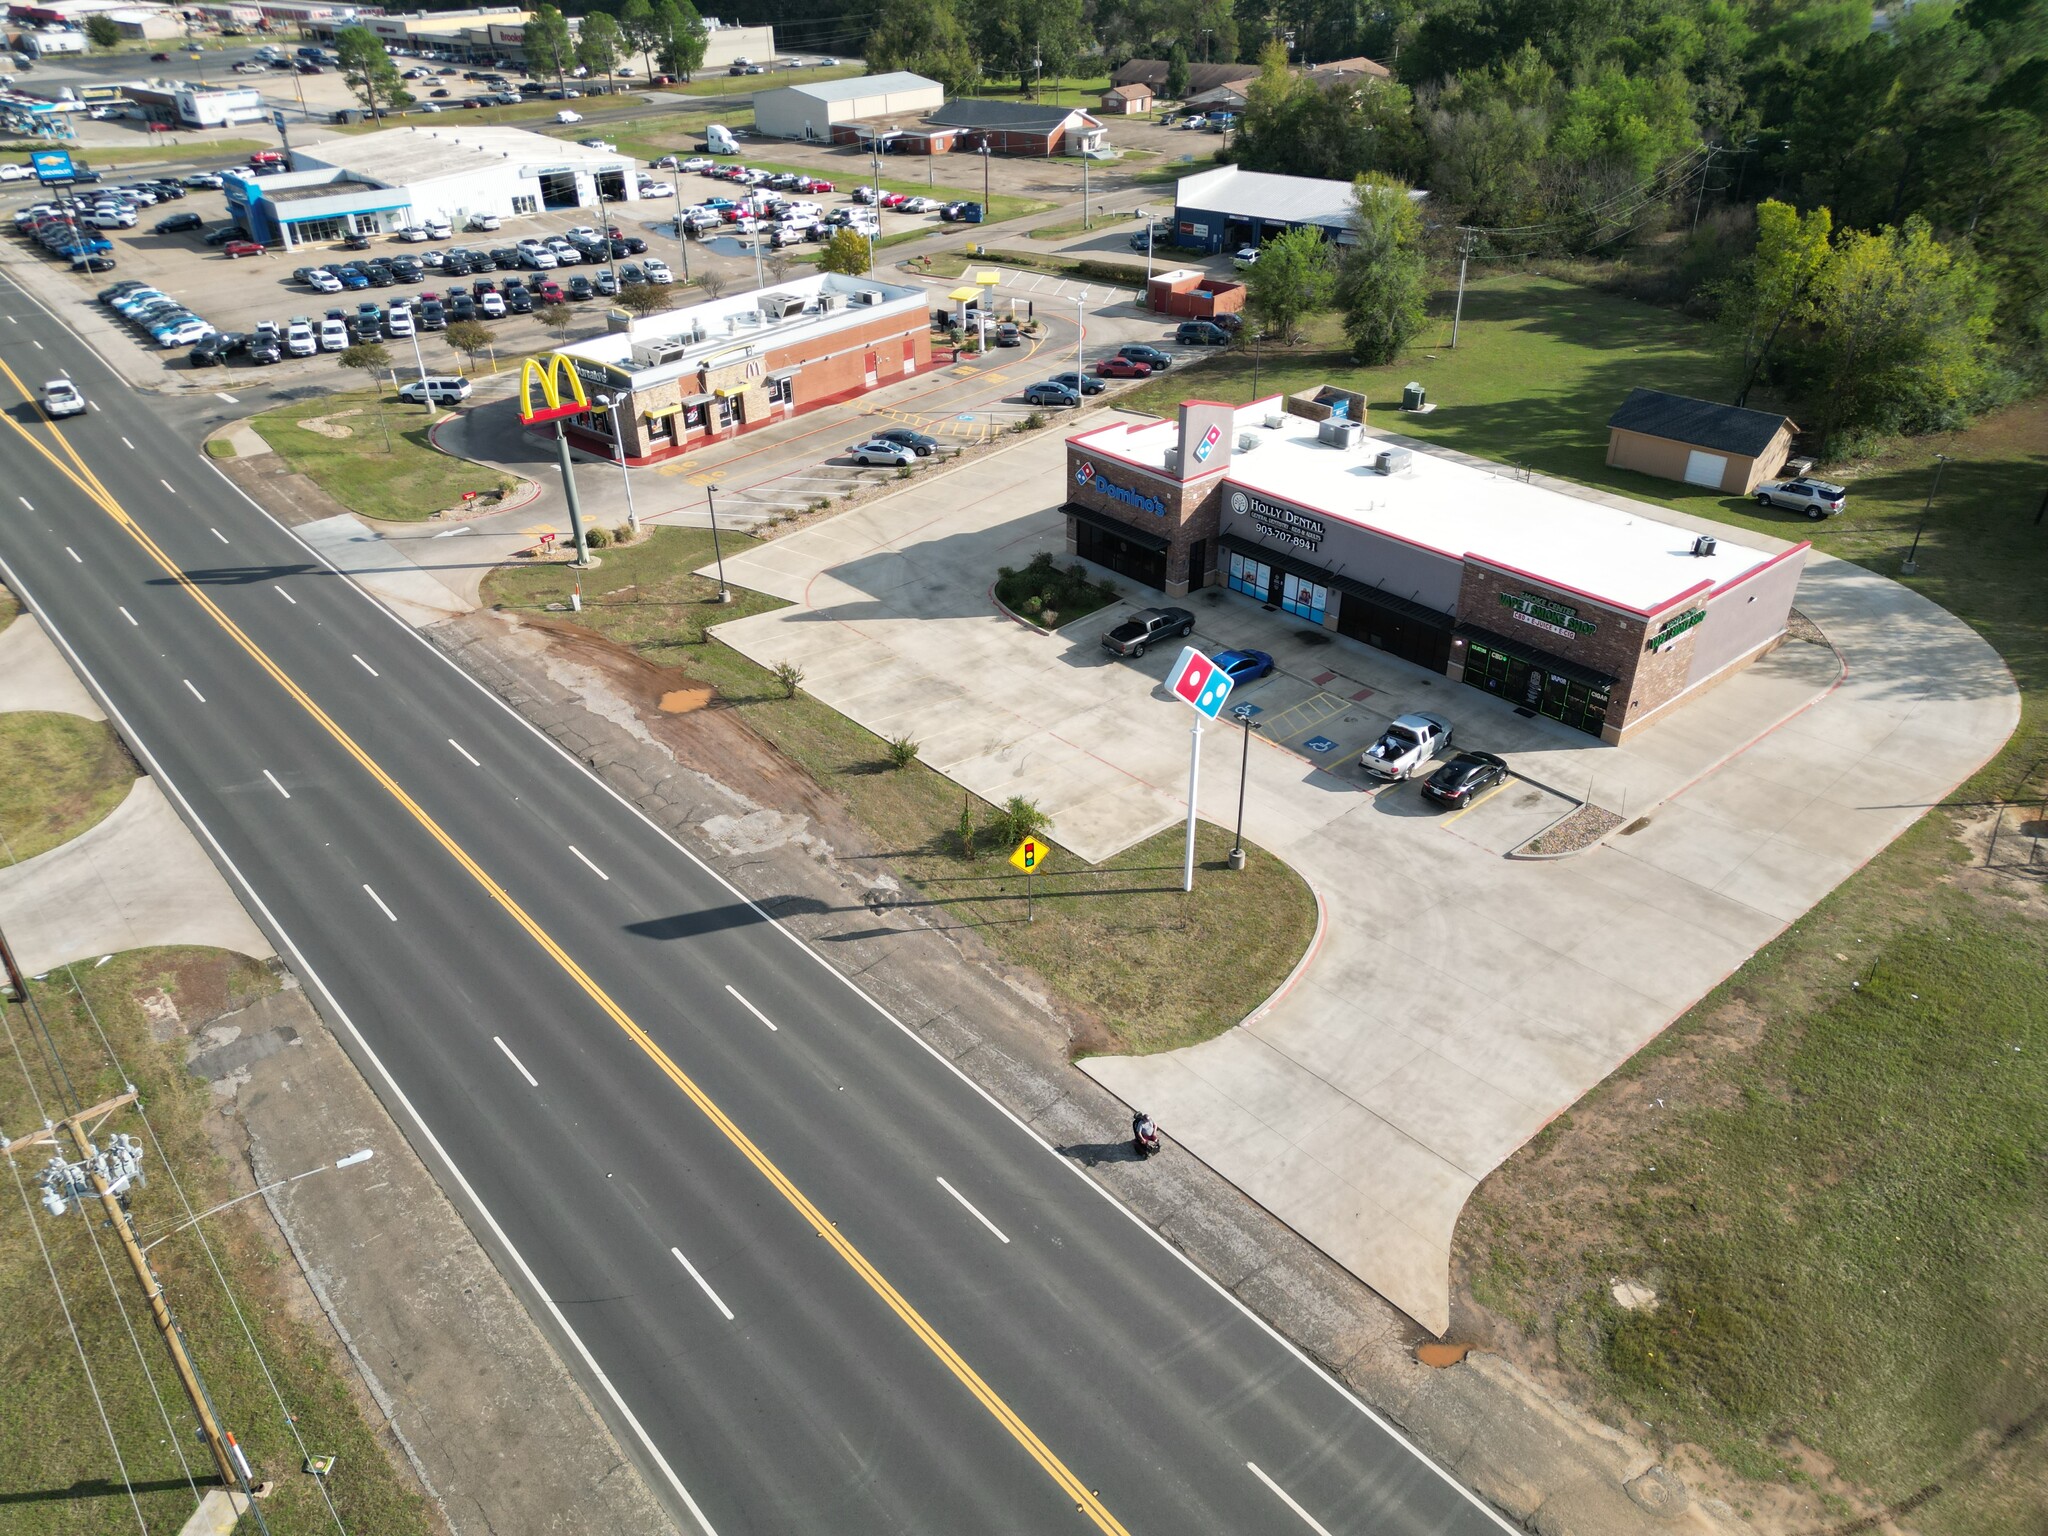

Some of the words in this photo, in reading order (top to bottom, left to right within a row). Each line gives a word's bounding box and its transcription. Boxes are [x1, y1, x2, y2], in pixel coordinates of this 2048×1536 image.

[1096, 475, 1165, 517] Domino's
[1251, 499, 1282, 518] HOLLY
[1285, 511, 1324, 533] DENTAL
[1256, 523, 1316, 552] 903-707-8941
[1500, 592, 1524, 611] VAPE
[1531, 604, 1566, 626] SMOKE
[1567, 616, 1597, 636] SHOP
[1547, 603, 1577, 617] CENTER
[1514, 612, 1526, 621] CBD
[1531, 619, 1553, 631] E-JUICE
[1558, 628, 1575, 639] E-CIG
[1591, 691, 1608, 702] CIGAR
